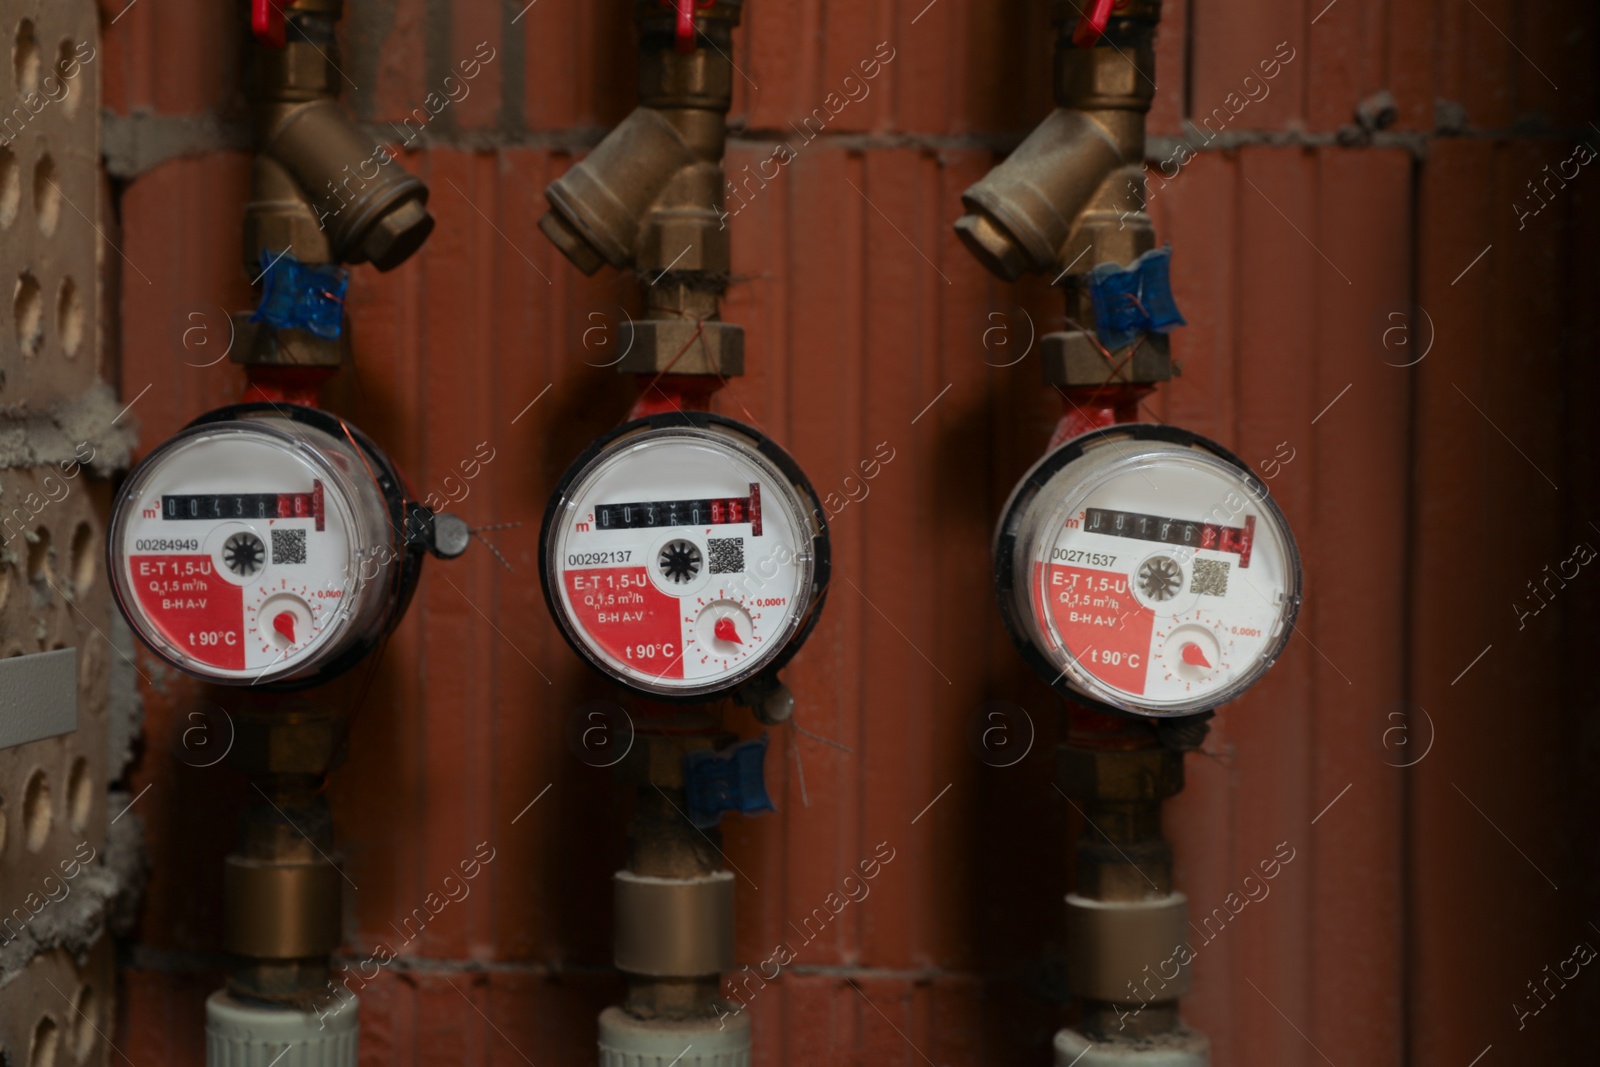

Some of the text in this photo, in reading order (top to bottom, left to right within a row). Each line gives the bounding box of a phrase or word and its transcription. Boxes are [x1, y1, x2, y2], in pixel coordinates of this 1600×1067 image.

[135, 538, 199, 551] 00284949
[568, 551, 632, 566] 00292137
[1052, 548, 1117, 567] 00271537
[139, 561, 211, 576] E-T 1,5-U
[574, 574, 647, 590] E-T 1,5-U
[1052, 572, 1127, 595] E-T 1,5-U
[162, 598, 207, 610] B-H A-V
[756, 597, 786, 608] 0,0001
[597, 611, 644, 623] B-H A-V
[1069, 612, 1116, 628] B-H A-V
[189, 630, 237, 645] t 90°C
[1231, 626, 1261, 637] 0,0001
[626, 644, 675, 659] t 90°C
[1091, 649, 1141, 669] t 90°C
